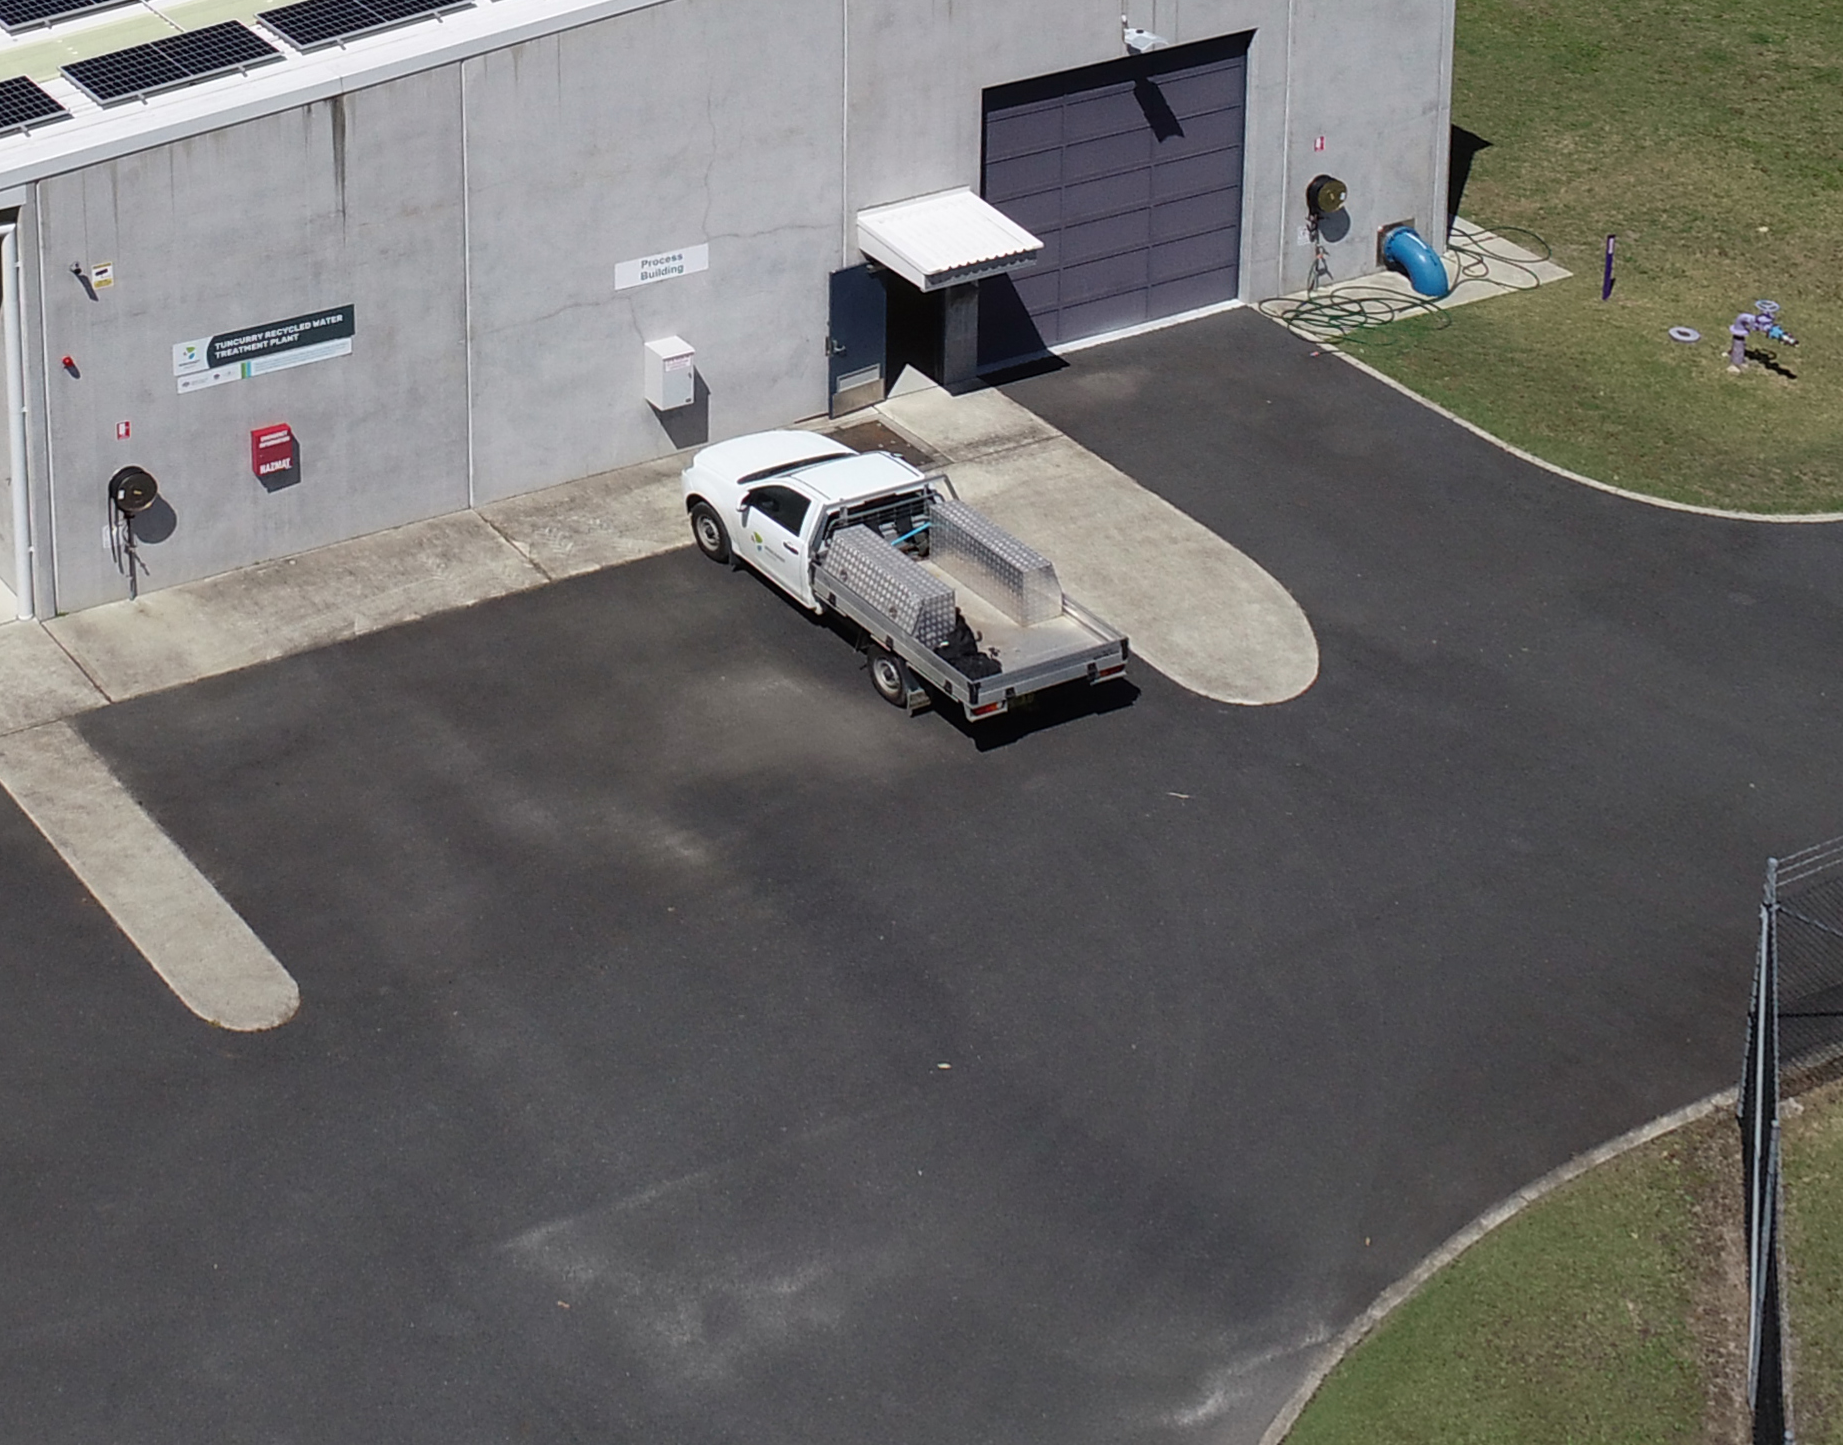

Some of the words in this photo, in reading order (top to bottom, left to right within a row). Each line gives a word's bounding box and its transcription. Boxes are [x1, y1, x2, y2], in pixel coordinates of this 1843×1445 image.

[641, 253, 683, 269] Process
[640, 264, 684, 280] Building
[214, 332, 264, 350] TUNCURRY
[264, 322, 311, 338] RECYCLED
[312, 314, 343, 328] WATER
[215, 340, 269, 360] TREATMENT
[269, 333, 299, 346] PLANT
[260, 457, 291, 475] HAZMAT
